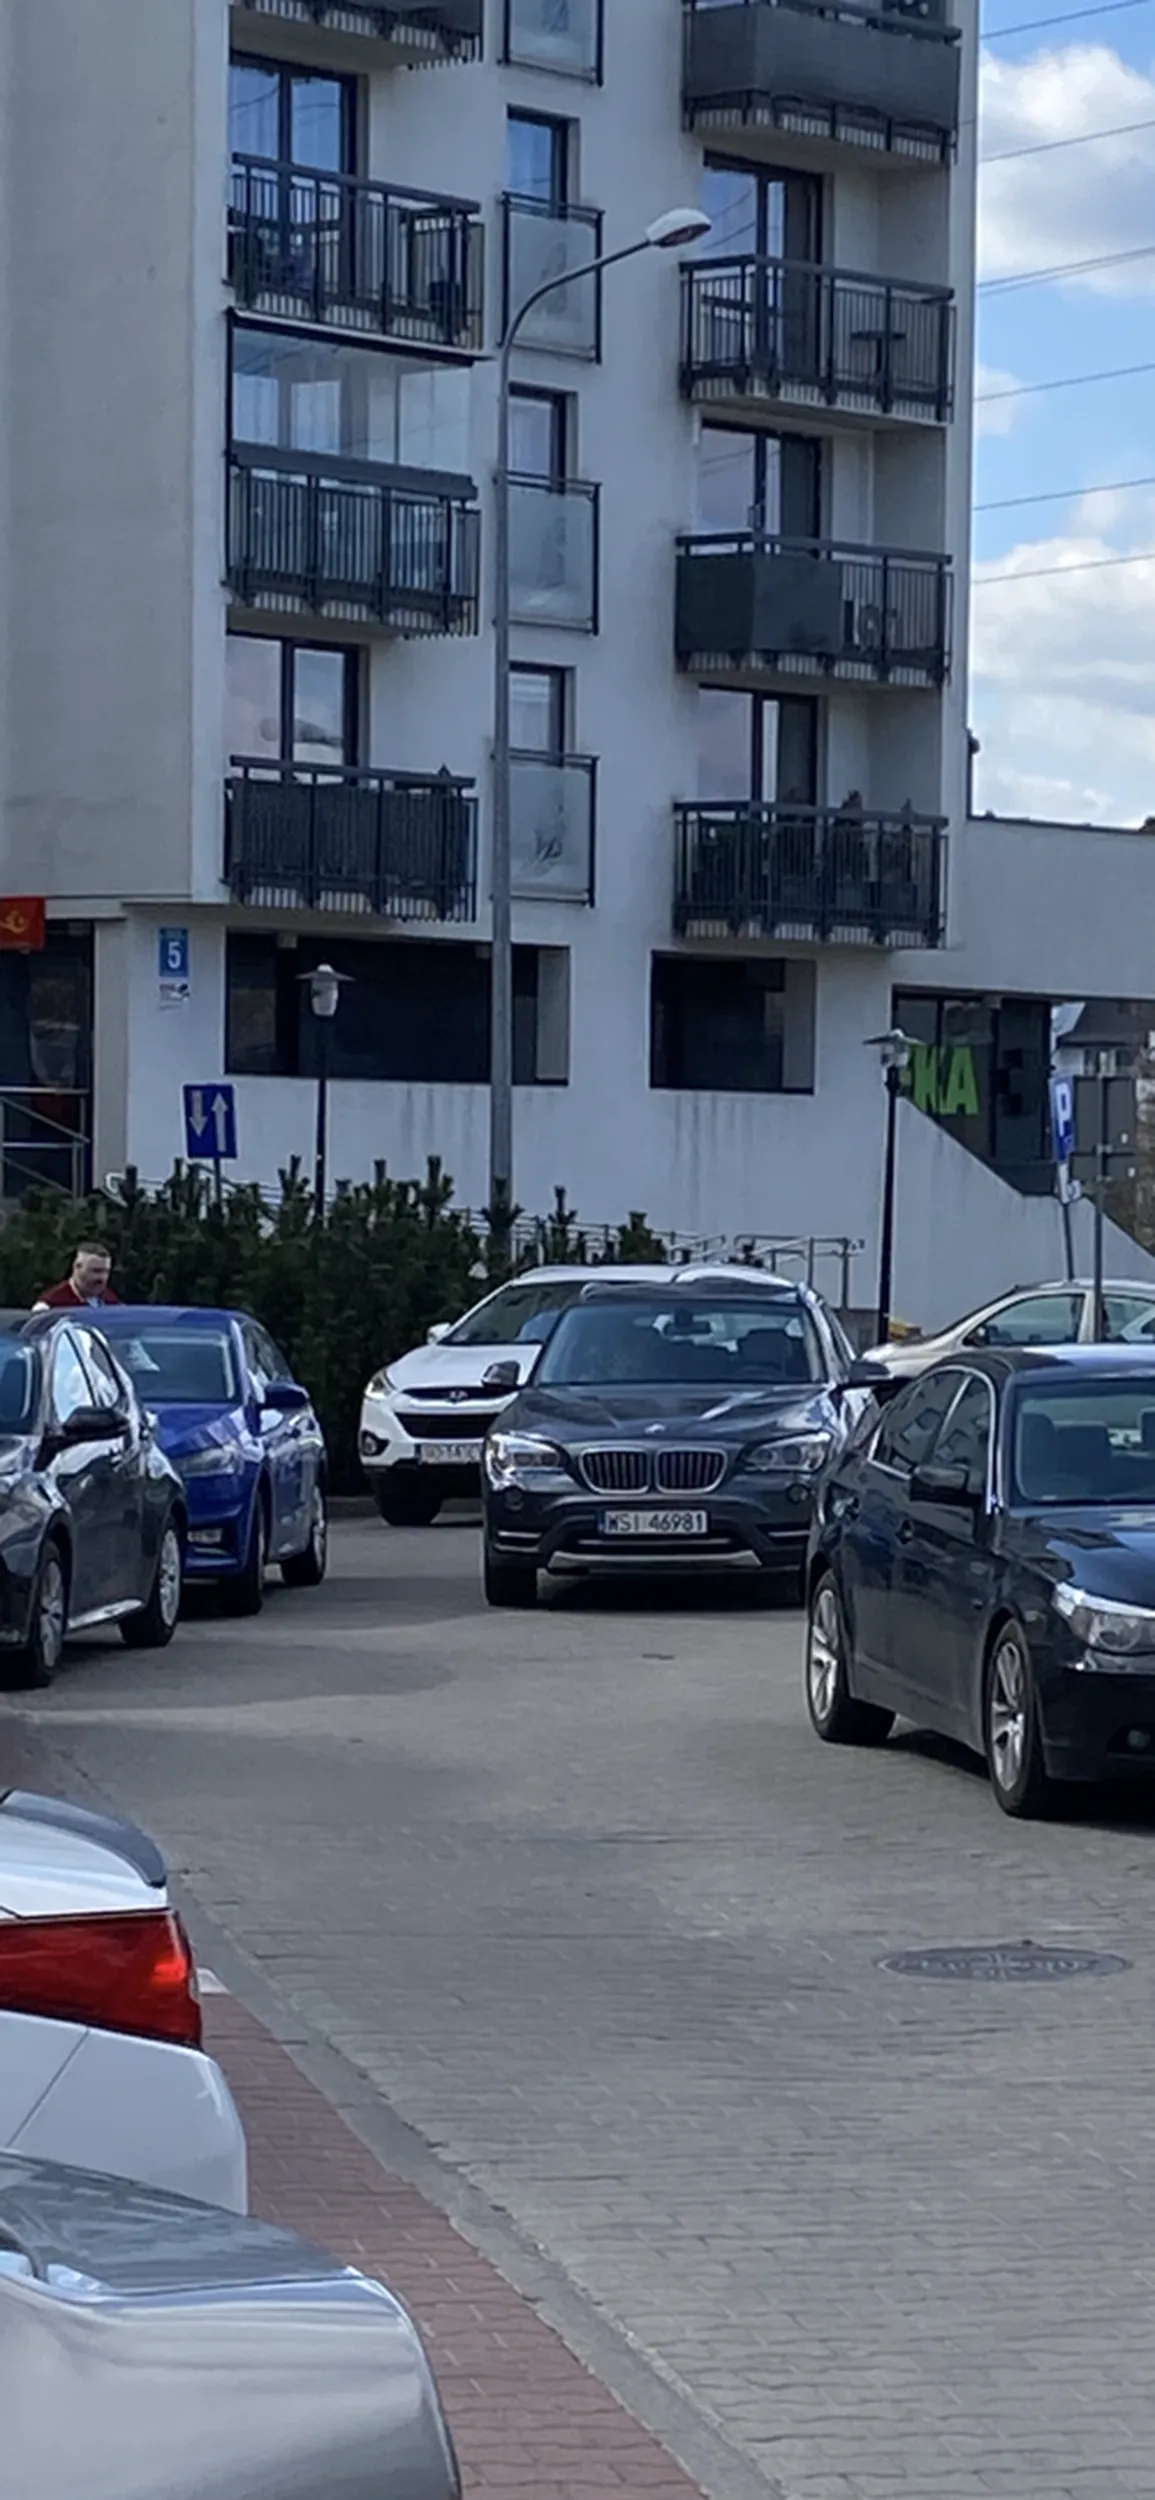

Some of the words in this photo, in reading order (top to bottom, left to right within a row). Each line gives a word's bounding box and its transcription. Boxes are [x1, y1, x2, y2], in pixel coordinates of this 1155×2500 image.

[168, 941, 182, 970] 5
[900, 1045, 979, 1115] KA
[1055, 1082, 1072, 1137] P
[606, 1512, 640, 1533] WSI
[647, 1512, 704, 1533] 46981
